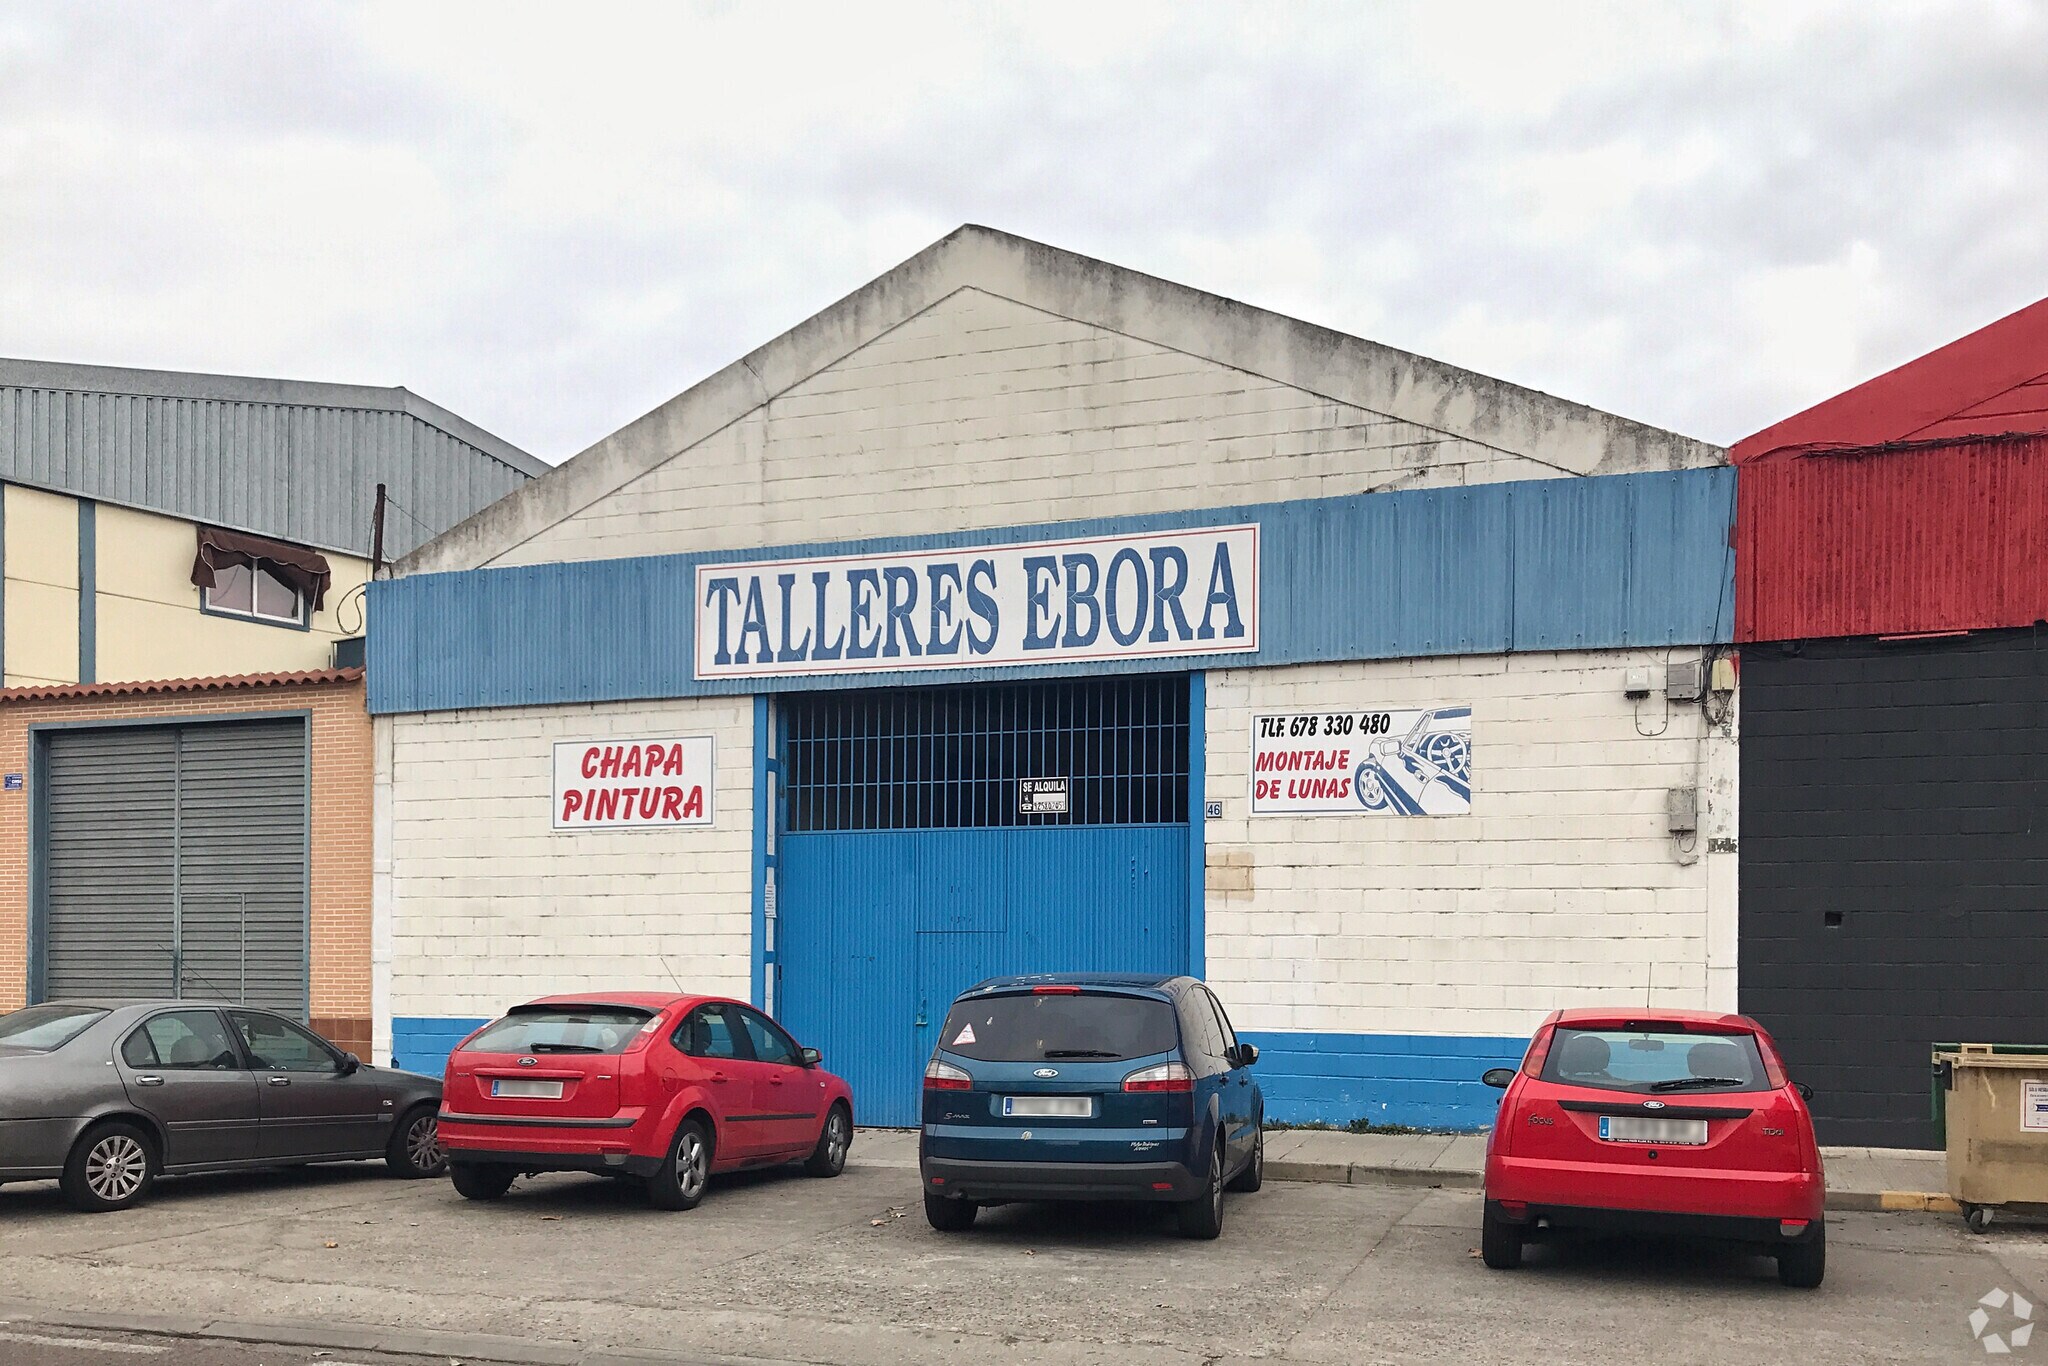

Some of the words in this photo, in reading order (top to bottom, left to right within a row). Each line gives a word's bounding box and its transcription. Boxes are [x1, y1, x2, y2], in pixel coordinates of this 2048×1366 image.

[705, 559, 999, 665] TALLERES
[1022, 541, 1245, 651] EBORA
[1260, 717, 1284, 738] TLF.
[1289, 715, 1318, 737] 678
[1324, 714, 1353, 736] 330
[1359, 713, 1390, 735] 480
[581, 743, 683, 779] CHAPA
[1255, 750, 1350, 771] MONTAJE
[1022, 781, 1033, 793] SE
[1034, 780, 1065, 792] ALQUILA
[1255, 779, 1281, 800] DE
[1287, 777, 1351, 799] LUNAS
[562, 785, 703, 822] PINTURA
[1207, 803, 1220, 816] 46
